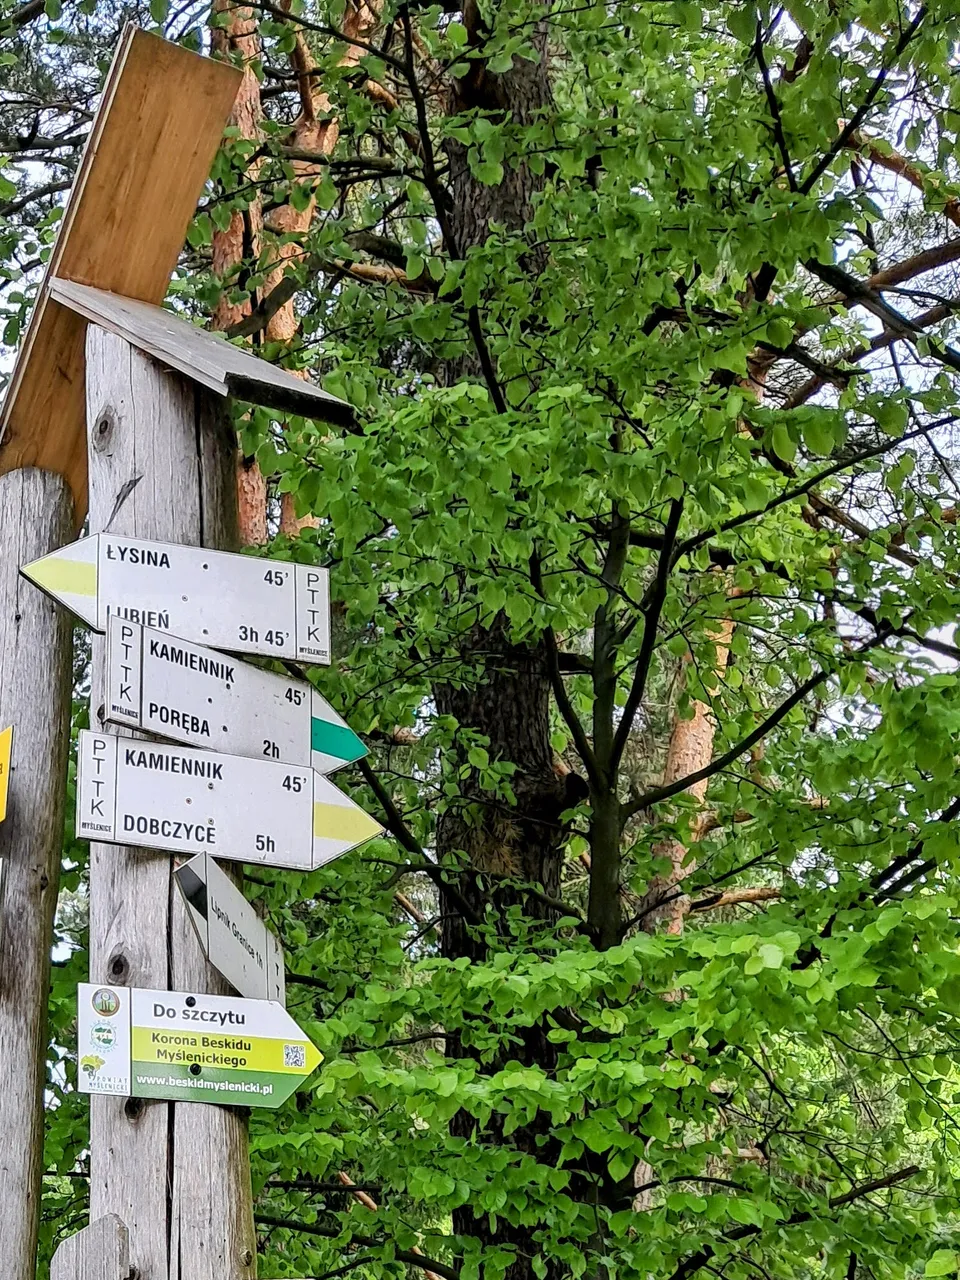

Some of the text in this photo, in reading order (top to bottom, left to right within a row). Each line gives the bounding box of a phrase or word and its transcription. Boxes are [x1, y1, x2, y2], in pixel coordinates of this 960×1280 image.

[107, 544, 171, 569] ŁYSINA
[306, 572, 321, 643] PTTK
[239, 625, 259, 643] 3h
[120, 626, 134, 703] PTTK
[150, 640, 235, 684] KAMIENNIK
[149, 702, 210, 737] PORĘBA
[263, 740, 280, 759] 2h
[125, 749, 223, 780] KAMIENNIK
[91, 740, 106, 817] PTTK
[123, 815, 216, 845] DOBCZYCE
[255, 835, 275, 853] 5h
[153, 1003, 245, 1026] Do szczytu
[152, 1032, 251, 1051] Korona Beskidu
[156, 1048, 247, 1068] Myślenickiego
[136, 1074, 273, 1095] www.beskidmyslenicki.pl
